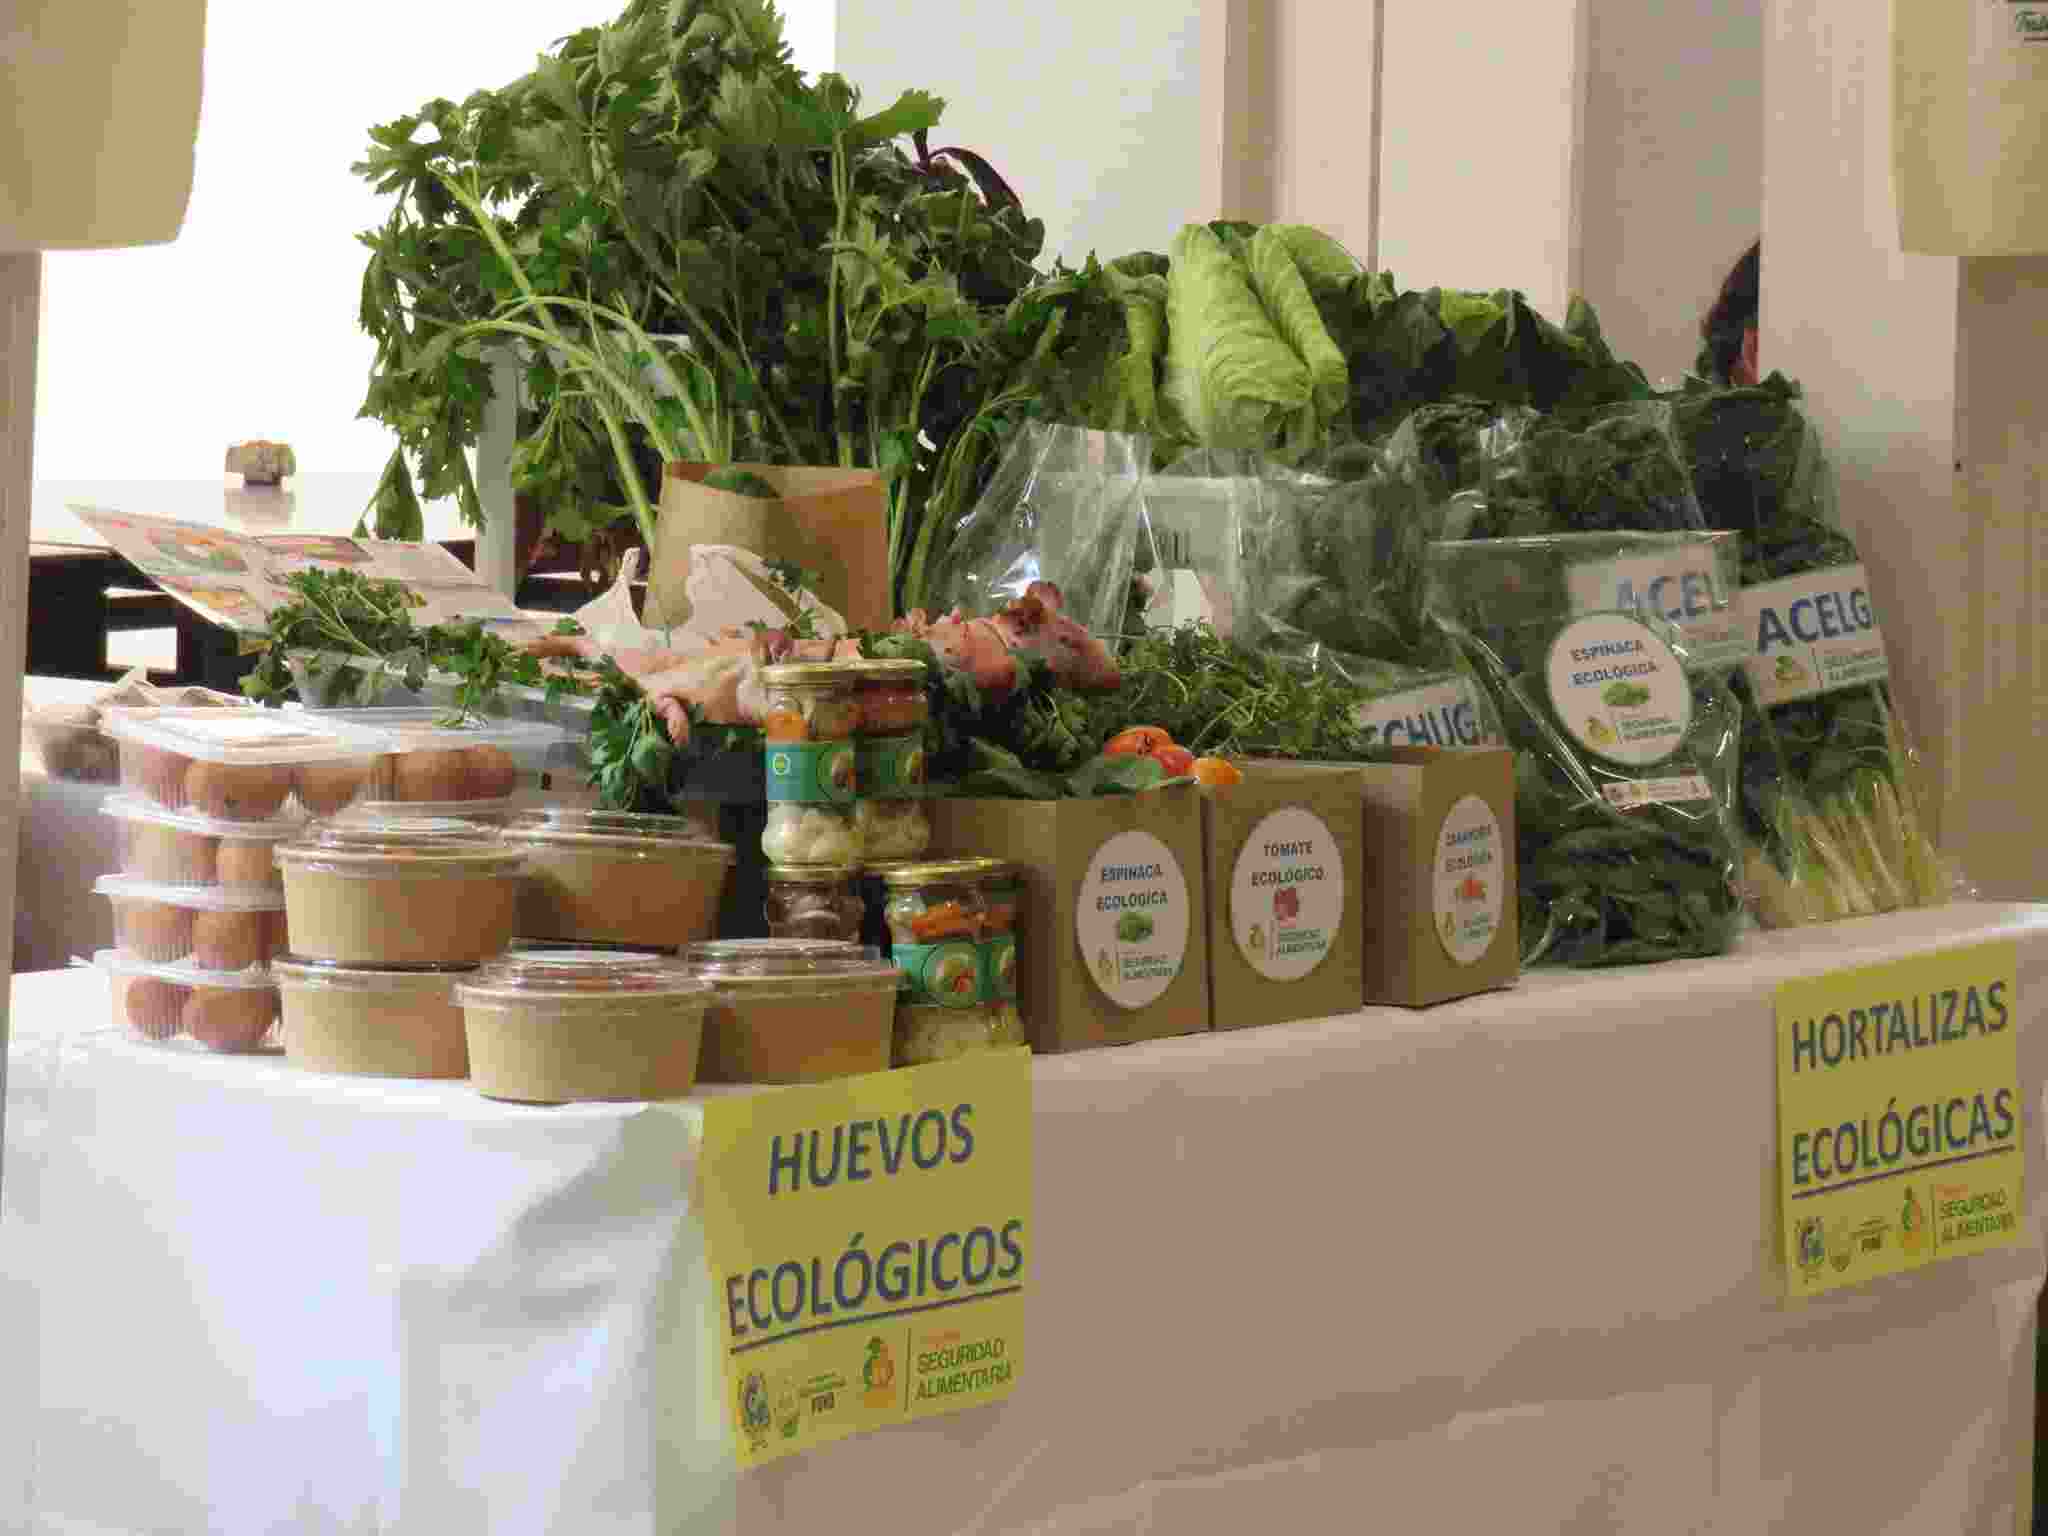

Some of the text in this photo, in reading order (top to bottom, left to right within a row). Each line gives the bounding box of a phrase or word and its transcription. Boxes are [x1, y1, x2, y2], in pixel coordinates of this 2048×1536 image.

[1570, 639, 1644, 661] ESPINACA
[1264, 840, 1313, 857] TOMATE
[1102, 864, 1163, 884] ESPINACA
[1792, 981, 2009, 1073] HORTALIZAS
[768, 1103, 975, 1197] HUEVOS
[1792, 1087, 2015, 1186] ECOLÓGICAS
[726, 1217, 1023, 1337] ECOLÓGICOS
[916, 1338, 1006, 1374] SEGURIDAD
[914, 1360, 1013, 1401] ALIMENTARIA
